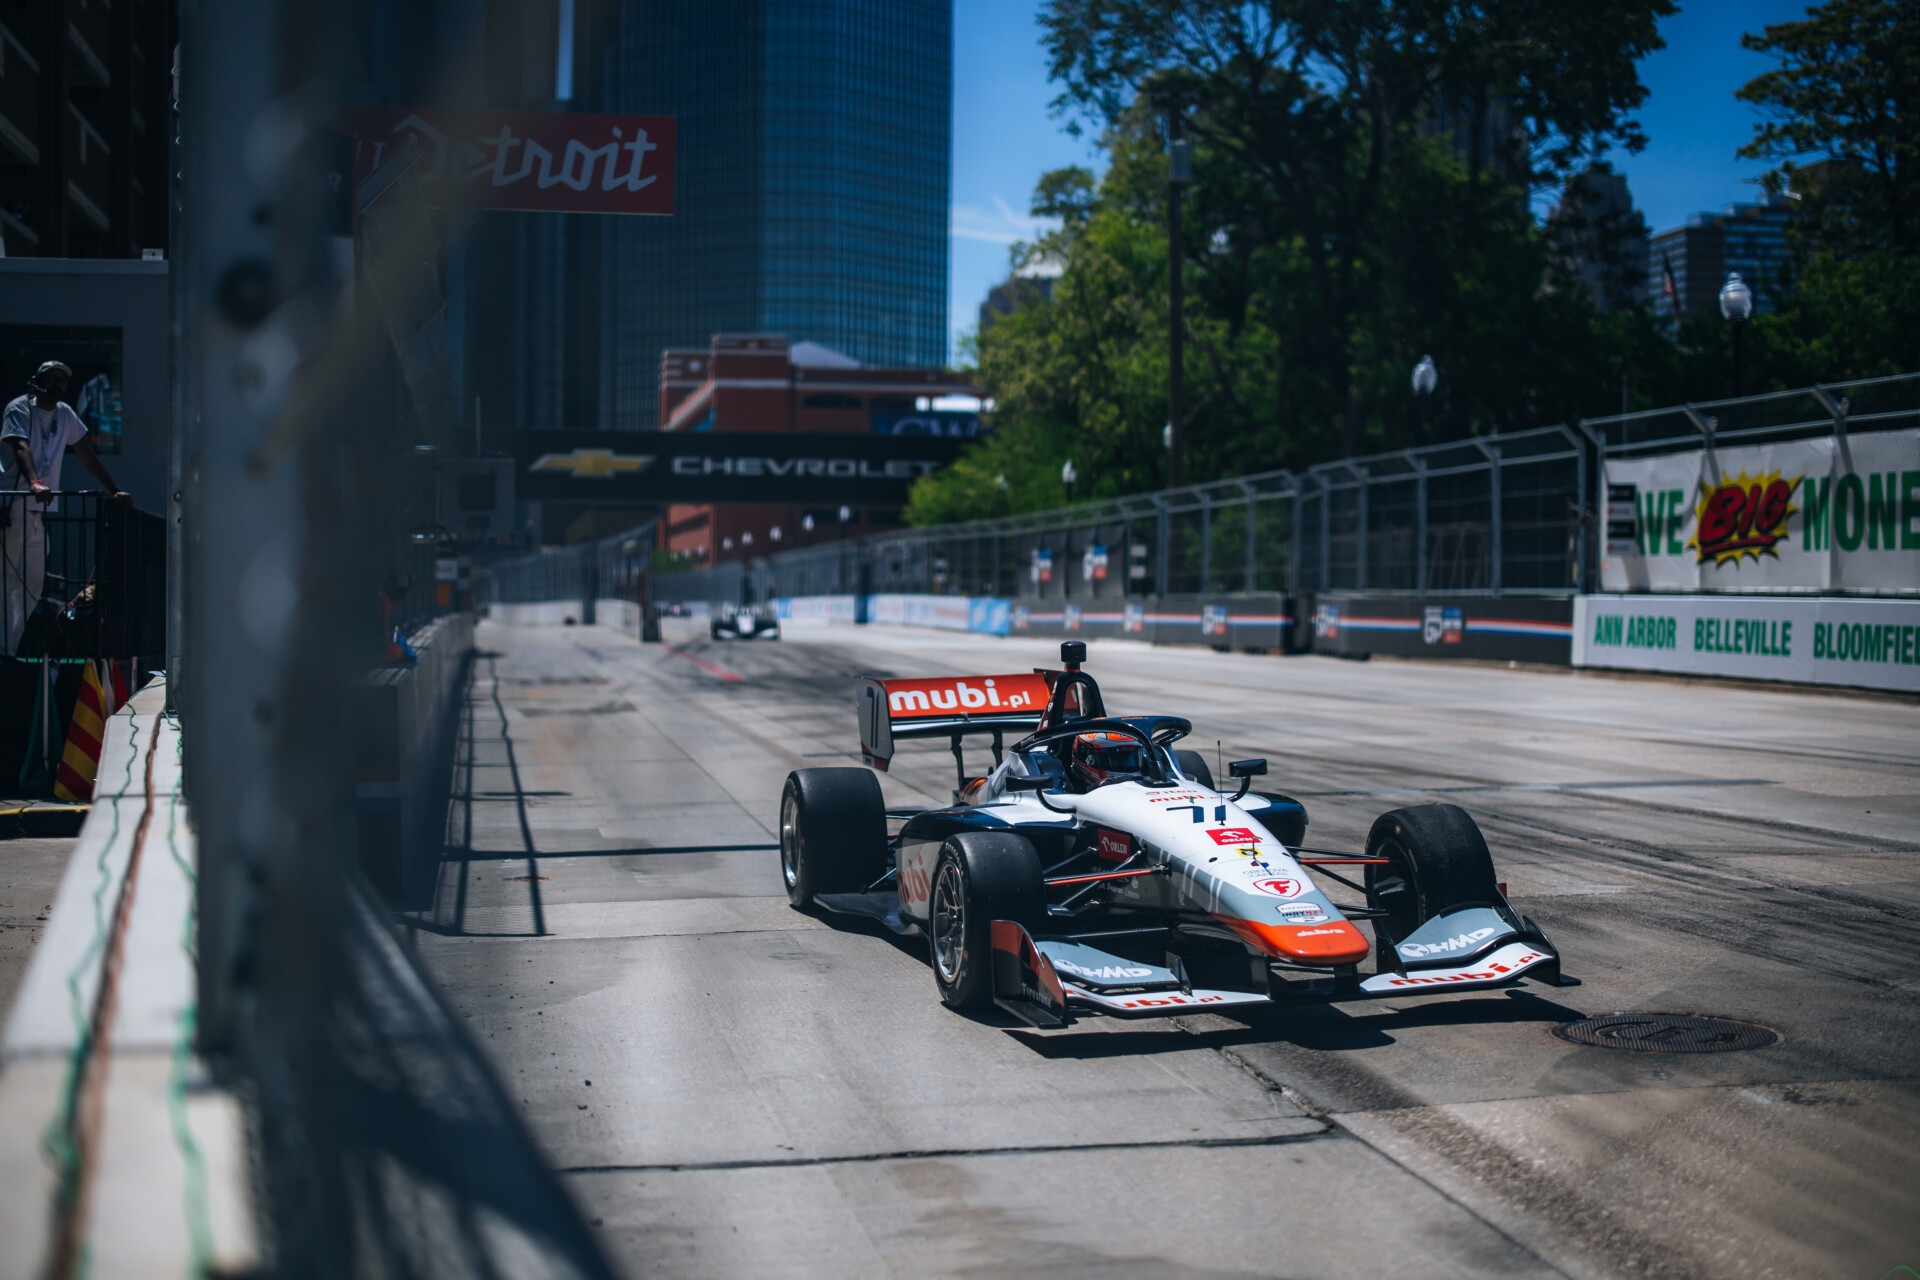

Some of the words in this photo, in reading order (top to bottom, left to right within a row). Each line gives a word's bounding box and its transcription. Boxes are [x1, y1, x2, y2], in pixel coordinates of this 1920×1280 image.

[672, 456, 939, 478] CHEVROLET
[1698, 479, 1791, 546] BIG
[1594, 615, 1623, 646] ANN
[1626, 616, 1677, 649] ARBOR
[1694, 618, 1793, 657] BELLEVILLE
[889, 679, 1031, 711] mubi.pl
[1110, 841, 1129, 855] ORLEN
